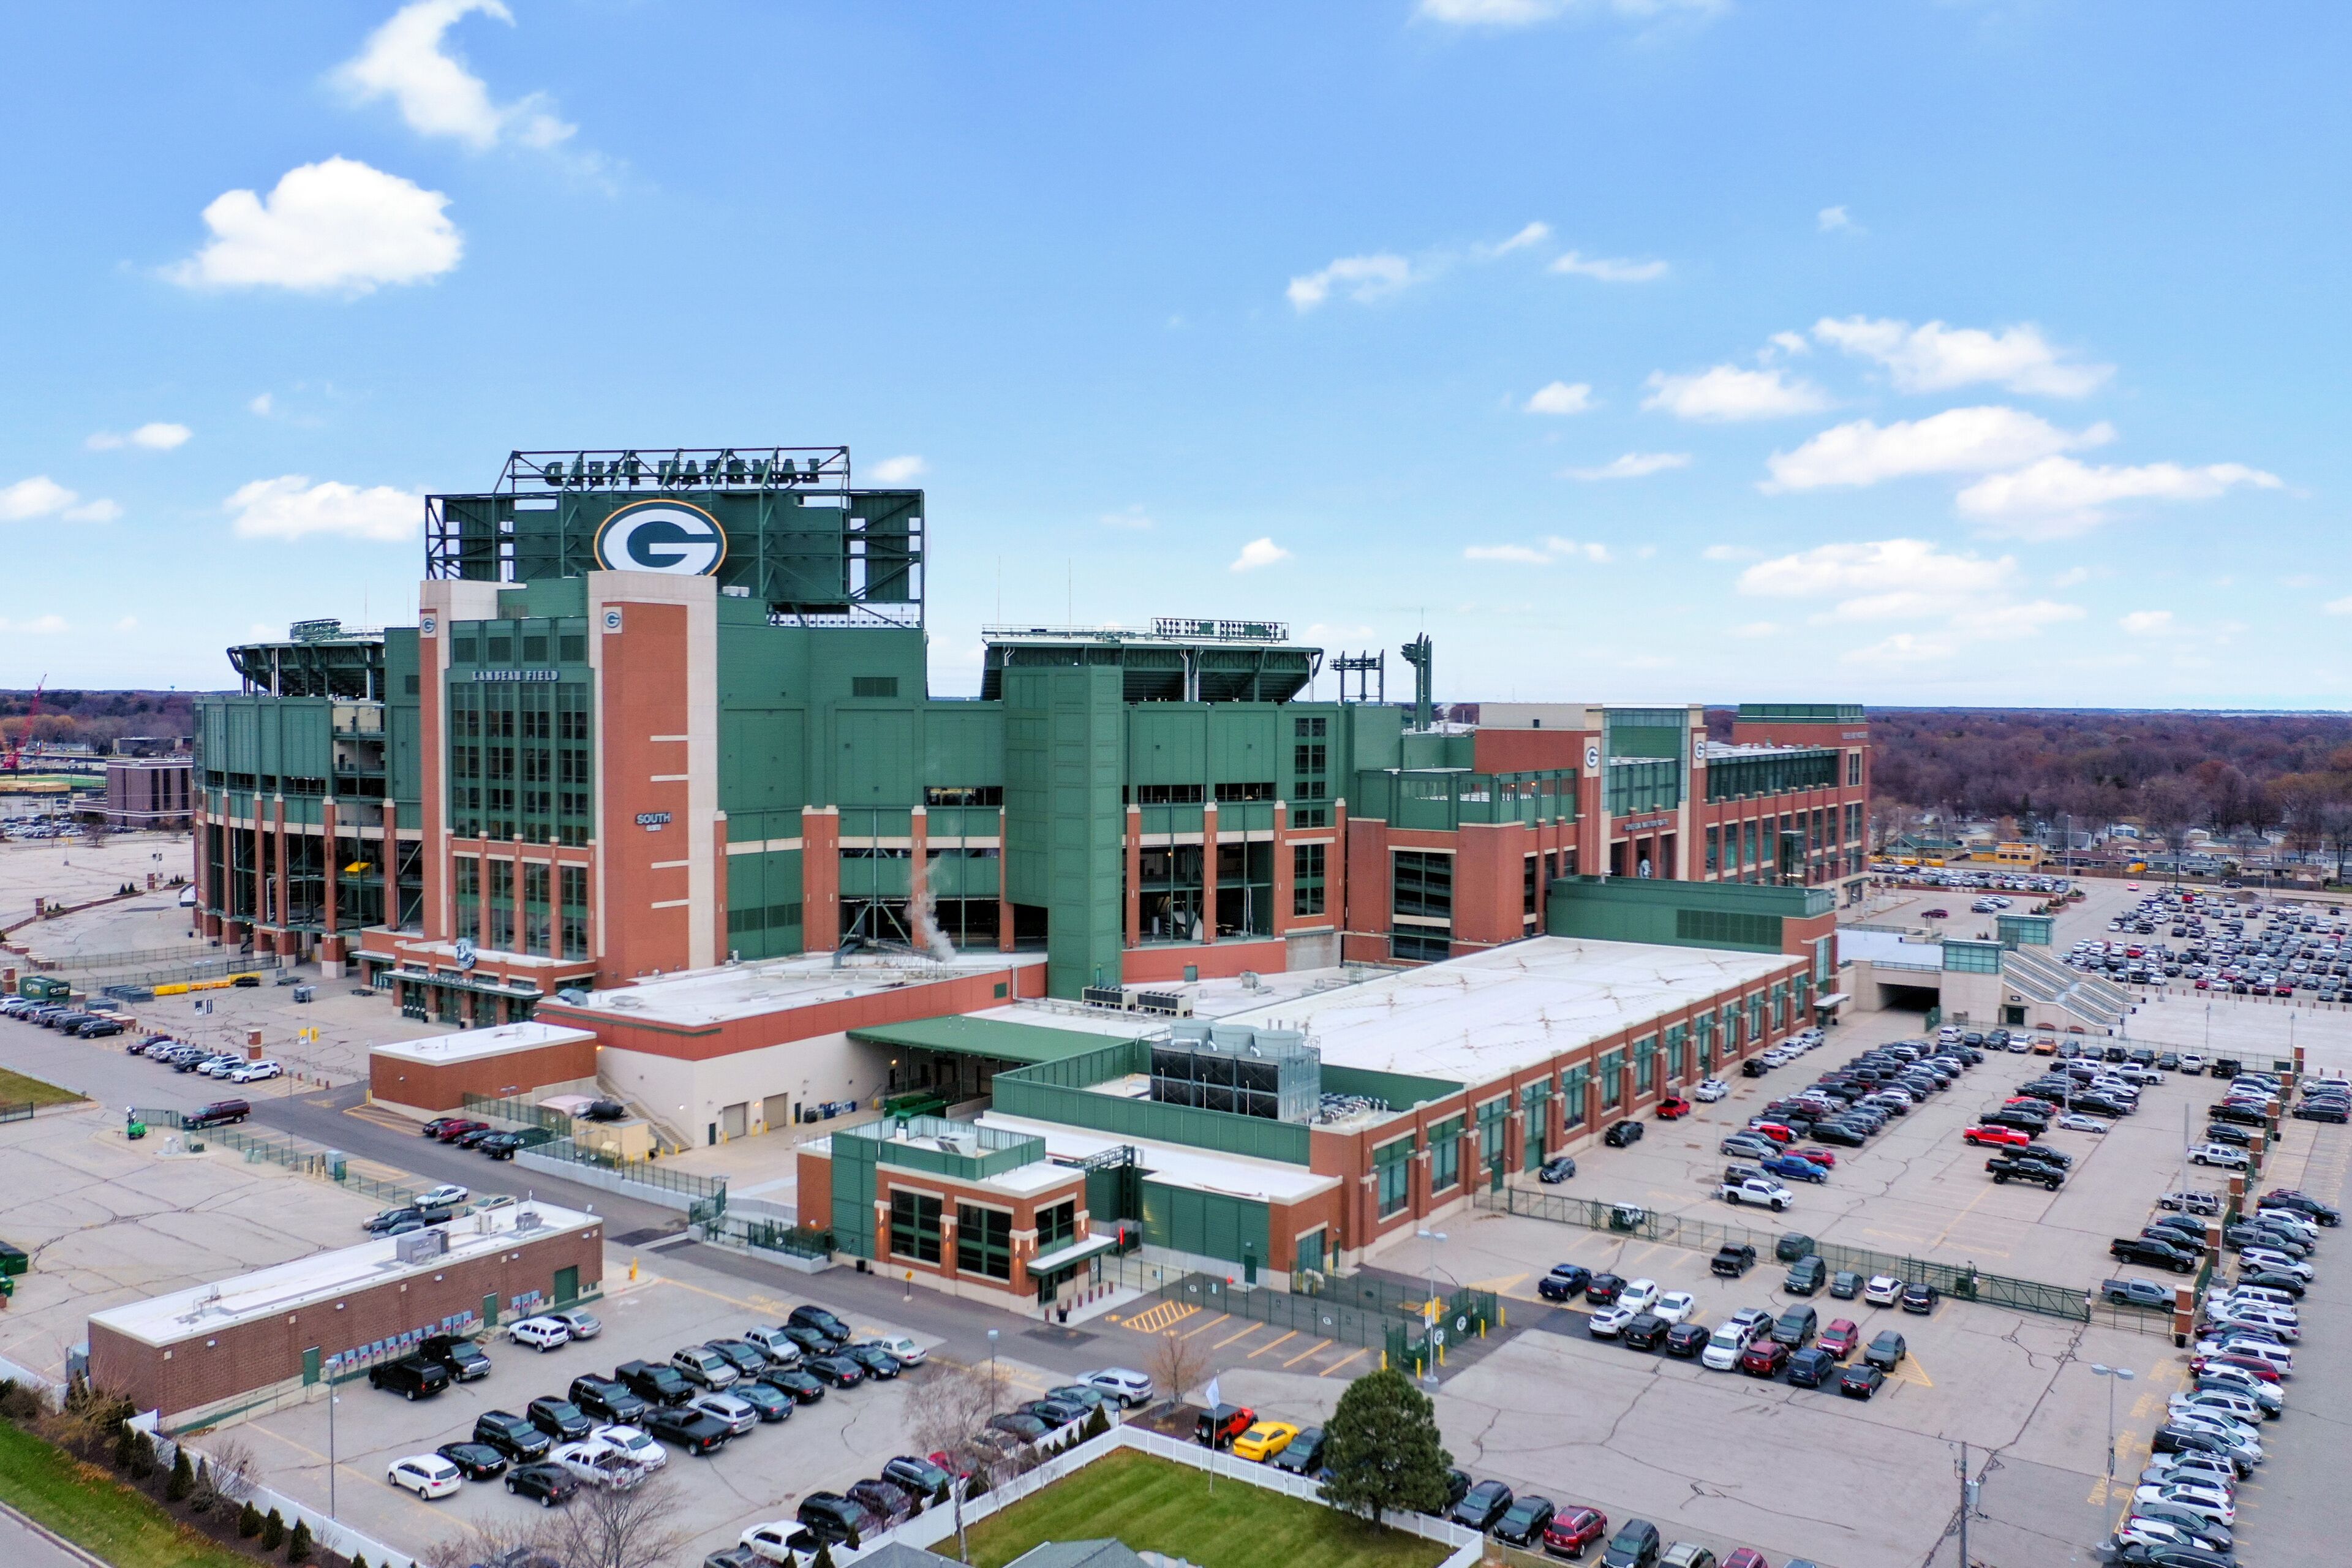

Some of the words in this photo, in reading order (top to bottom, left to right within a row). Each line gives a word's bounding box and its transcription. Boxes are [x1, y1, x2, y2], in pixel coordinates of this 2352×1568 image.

[603, 509, 717, 576] G
[472, 671, 521, 680] LAMBEAU
[526, 671, 559, 680] FIELD
[1586, 746, 1599, 768] G
[1694, 741, 1705, 760] G
[636, 812, 671, 824] SOUTH
